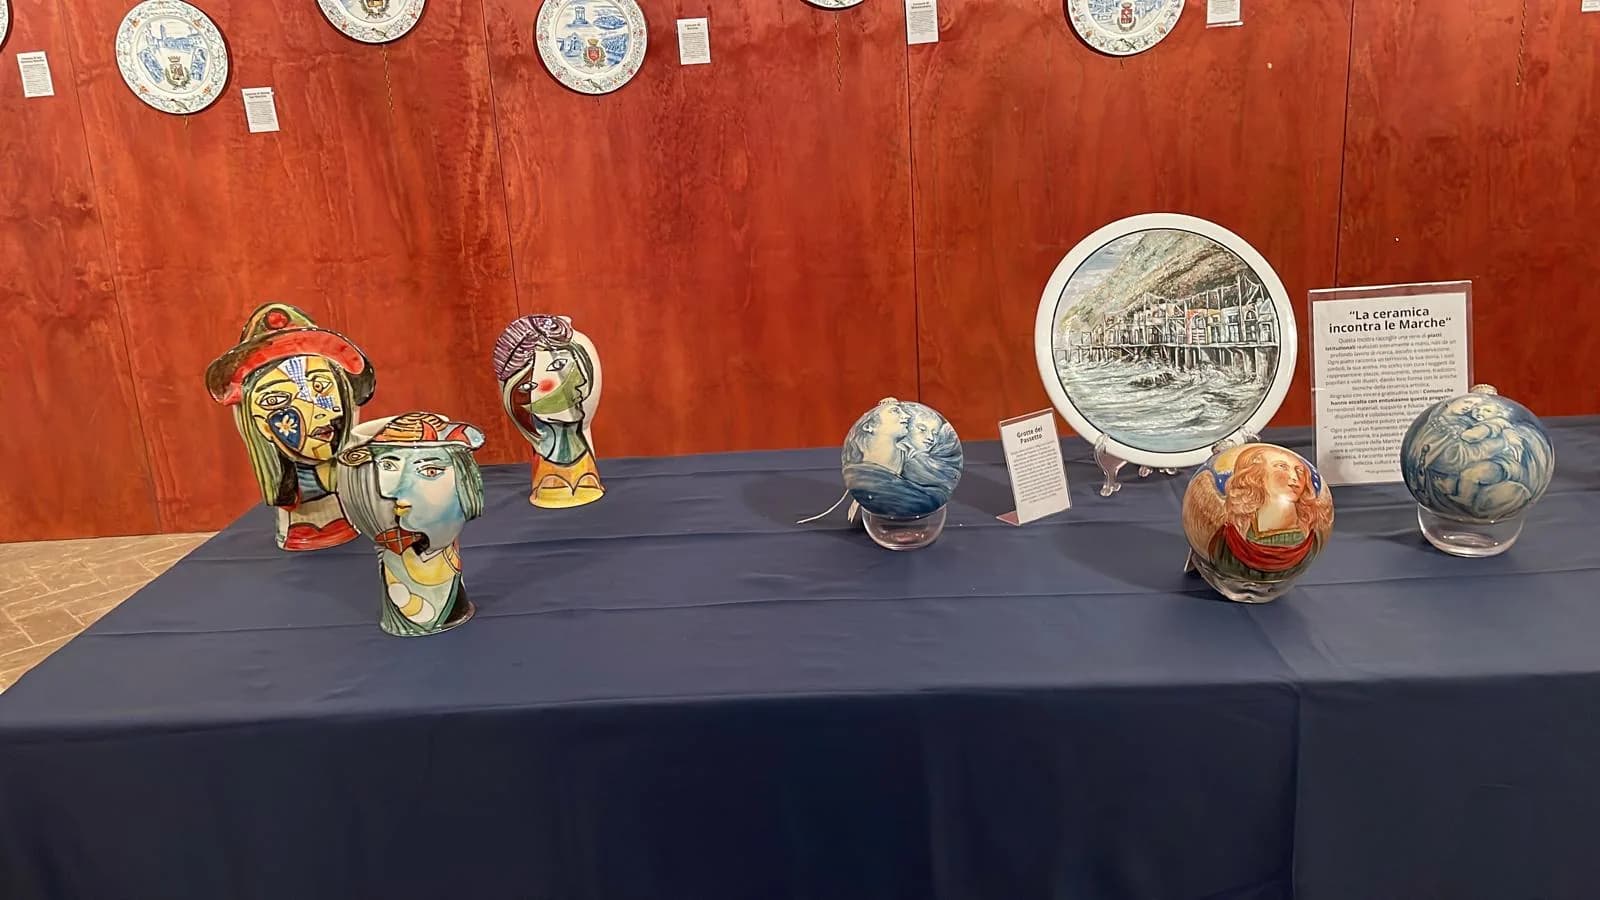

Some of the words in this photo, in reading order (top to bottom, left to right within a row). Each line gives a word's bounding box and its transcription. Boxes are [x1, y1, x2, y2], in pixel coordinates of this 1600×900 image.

[1349, 310, 1369, 320] “La
[1373, 306, 1430, 319] ceramica
[1329, 321, 1381, 334] incontra
[1384, 320, 1395, 330] le
[1399, 317, 1452, 330] Marche“
[1020, 434, 1043, 444] Passetto
